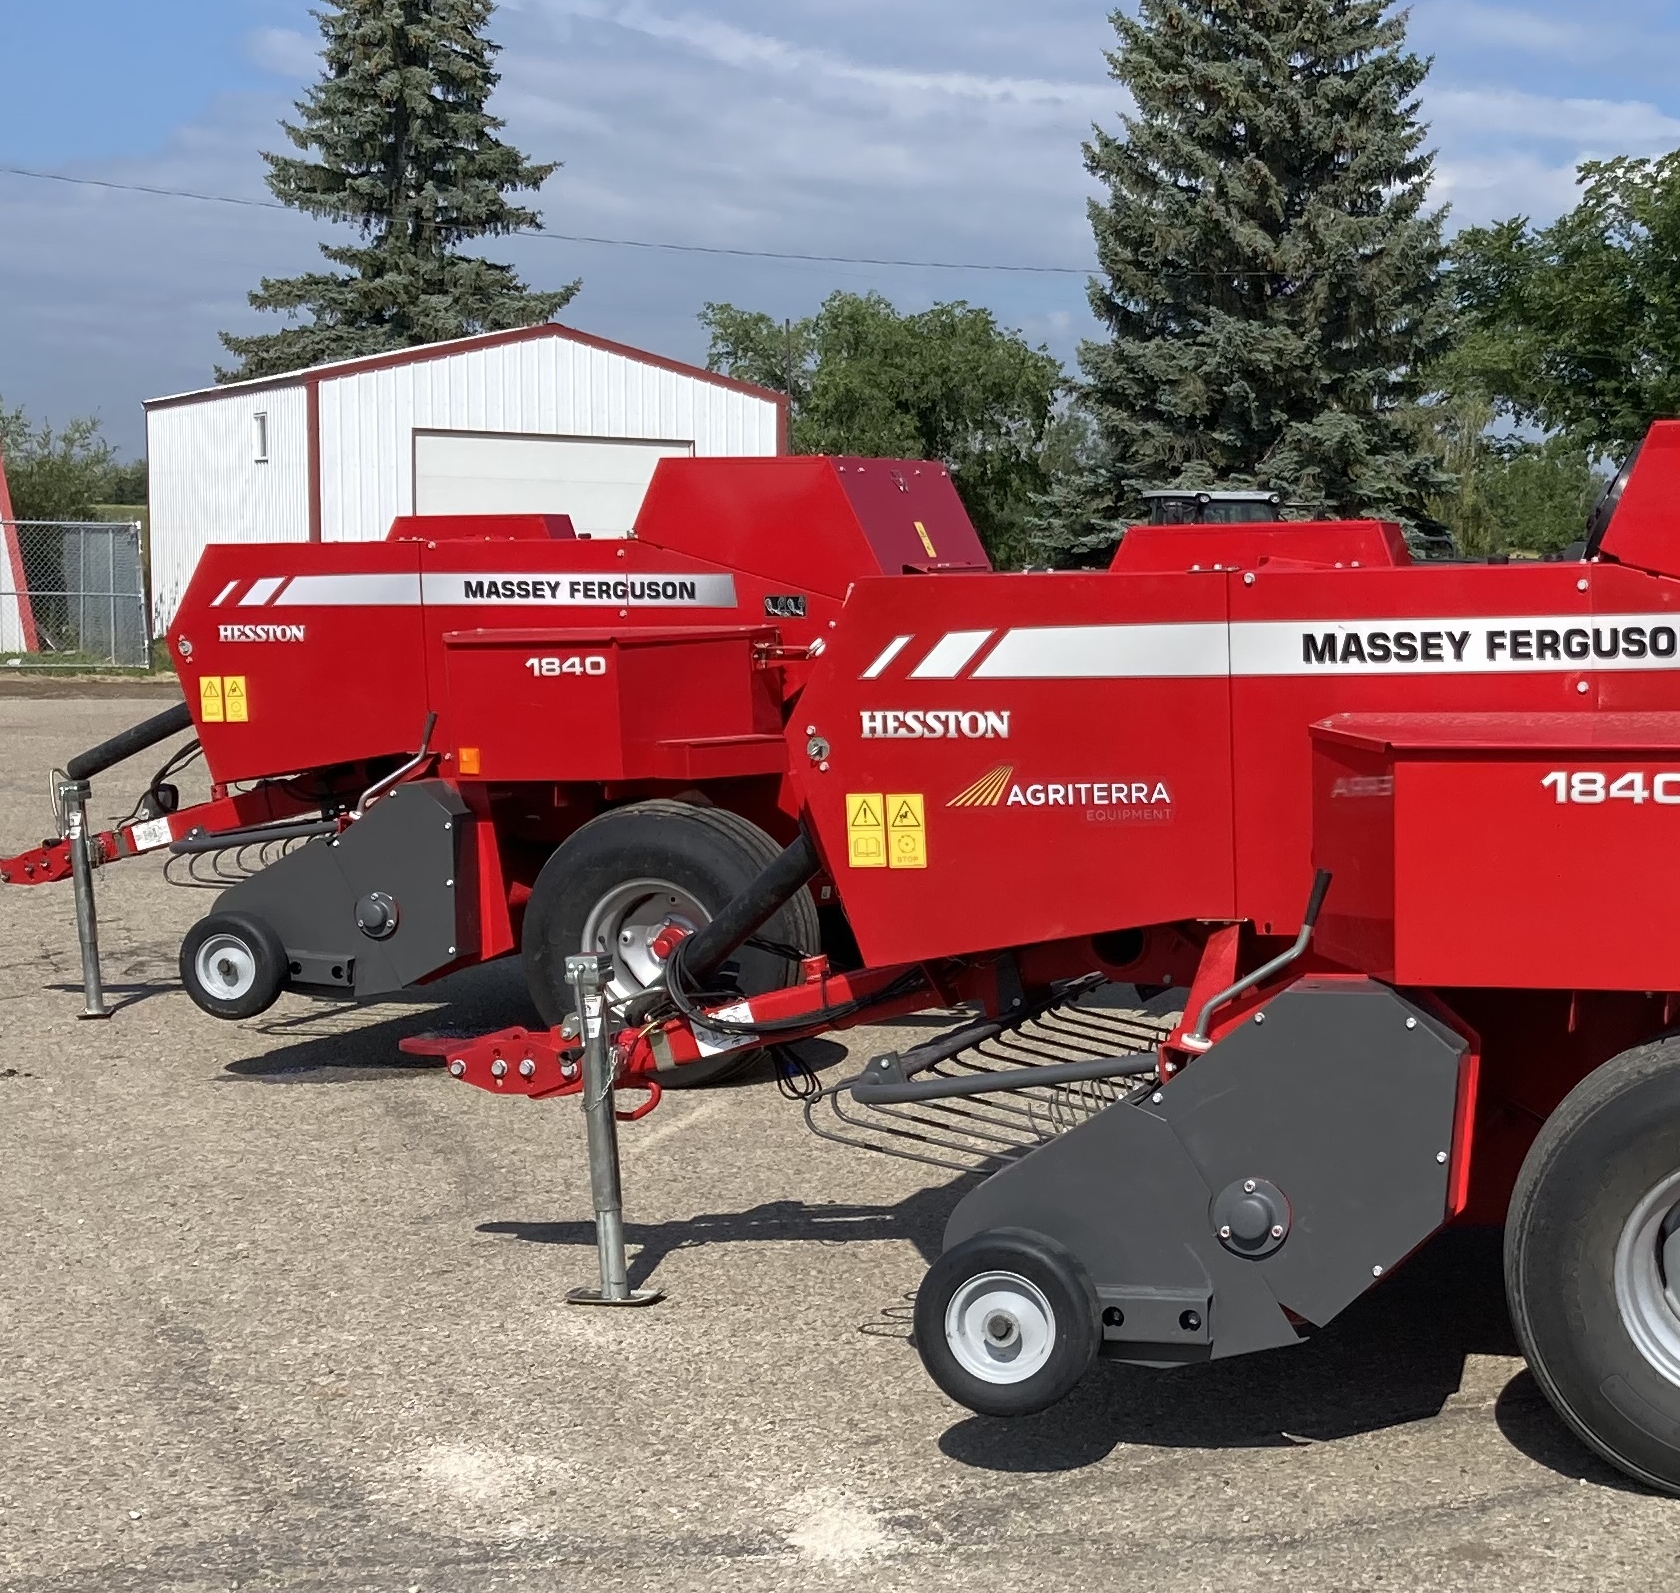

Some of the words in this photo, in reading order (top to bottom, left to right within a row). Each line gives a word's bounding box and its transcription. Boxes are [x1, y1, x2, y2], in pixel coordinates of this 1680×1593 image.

[463, 580, 560, 599] MASSEY
[569, 580, 696, 600] FERGUSON
[218, 624, 305, 642] HESSTON
[1302, 630, 1471, 664] MASSEY
[525, 656, 607, 677] 1840
[859, 710, 1010, 739] HESSTON
[1006, 782, 1171, 806] AGRITERRA
[1086, 809, 1172, 821] EQUIPMENT
